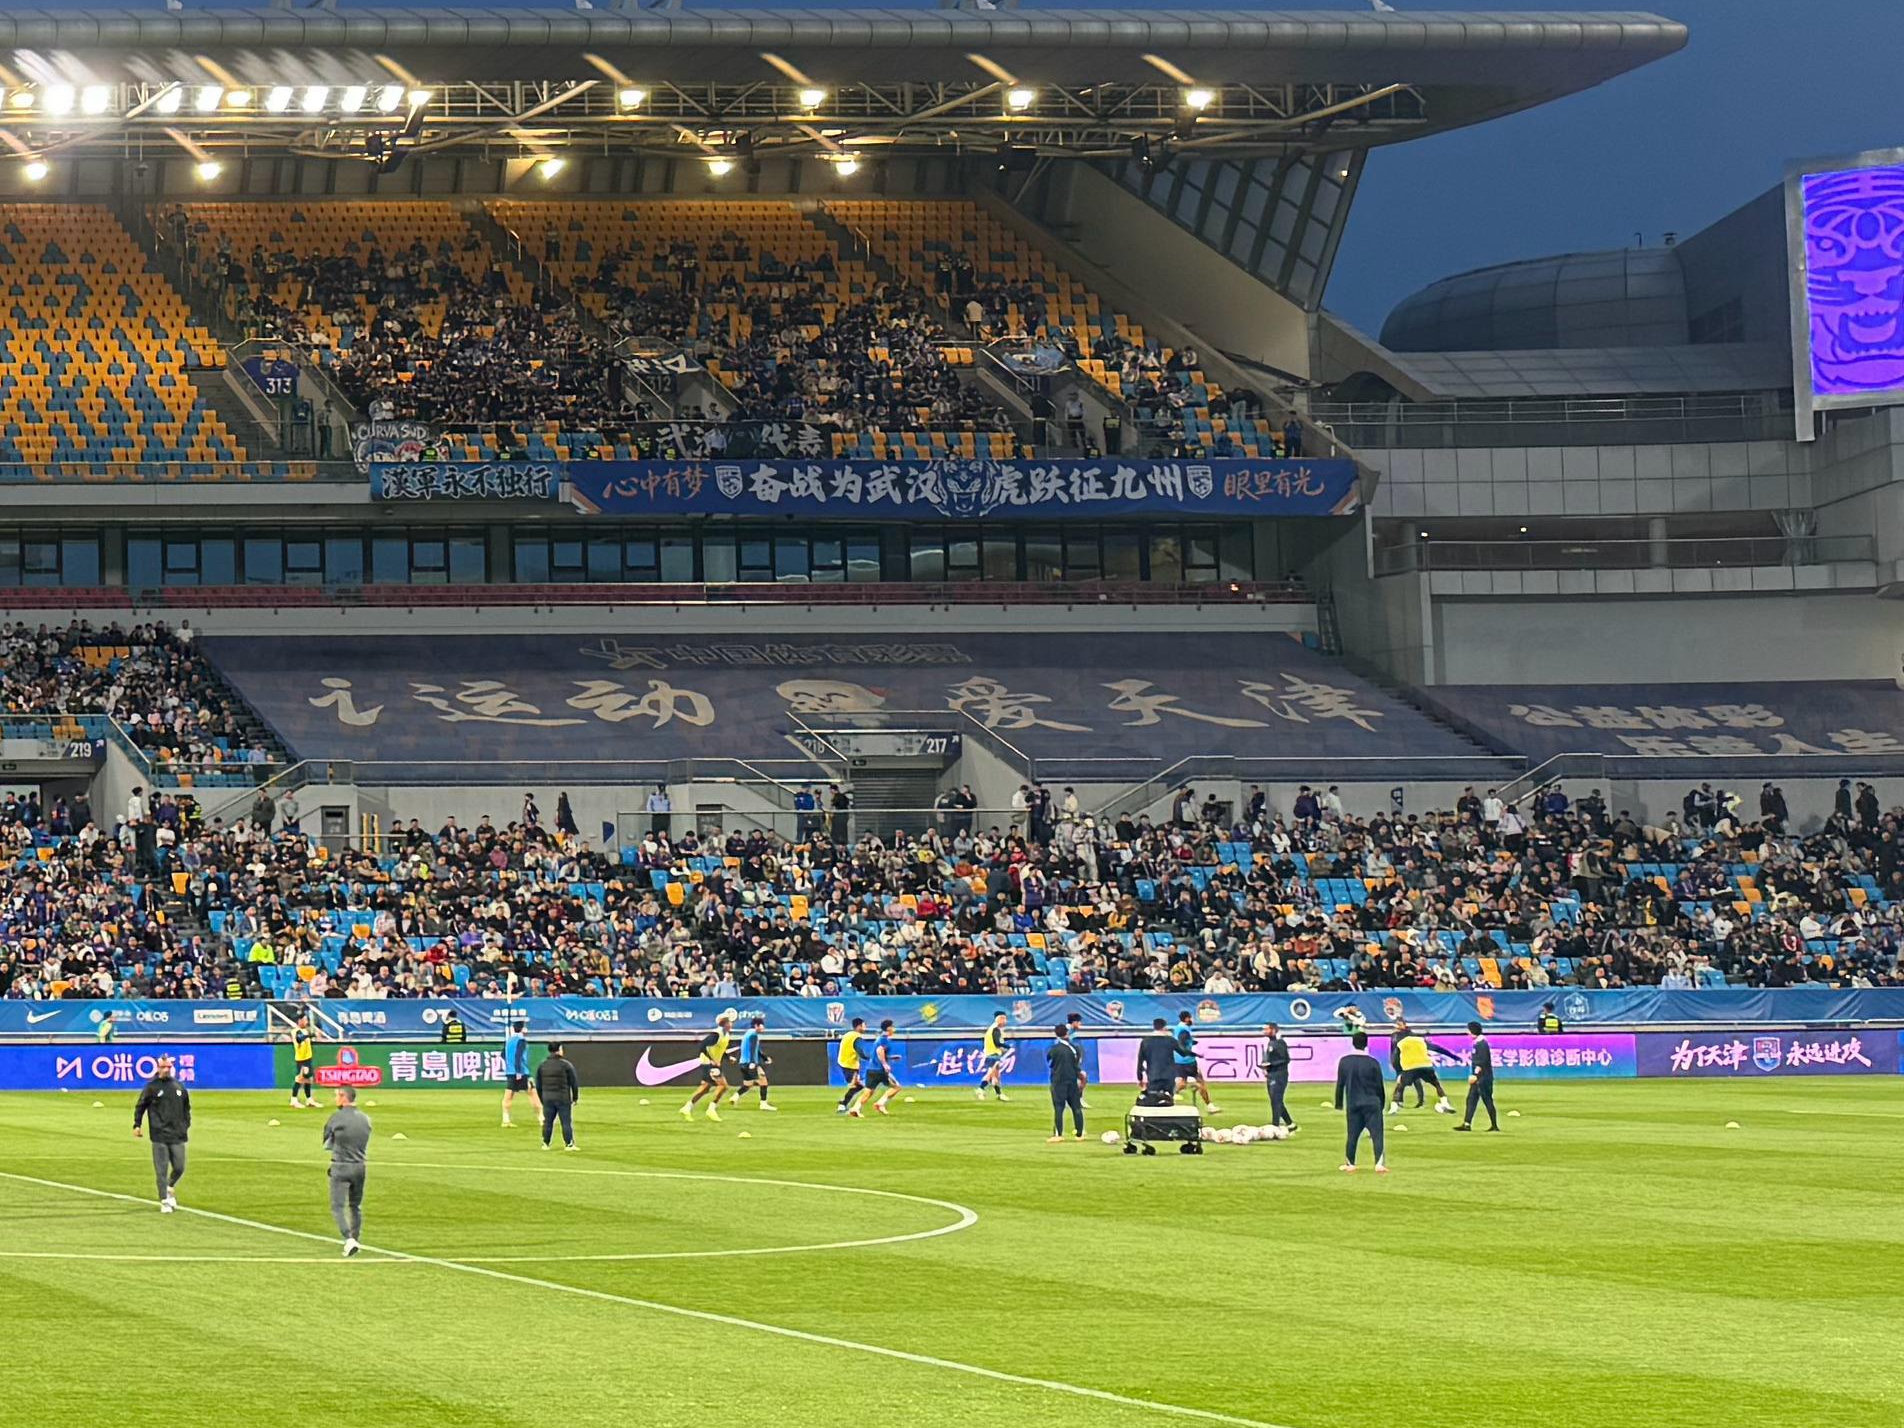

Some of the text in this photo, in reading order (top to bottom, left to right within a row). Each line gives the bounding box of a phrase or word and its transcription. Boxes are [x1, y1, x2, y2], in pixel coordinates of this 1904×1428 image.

[266, 376, 292, 394] 313
[357, 424, 428, 440] CURVA SUD
[380, 465, 554, 501] 漢軍永不独行
[602, 462, 1326, 504] 心中有梦 奋战为武汉 虎跃征九州 眼里有光
[946, 673, 1386, 732] 爱天津
[70, 742, 93, 758] 219
[926, 738, 947, 753] 217
[319, 1050, 507, 1083] TSINGTAO 青岛啤酒
[1670, 1039, 1872, 1072] 为了天津 永远进攻
